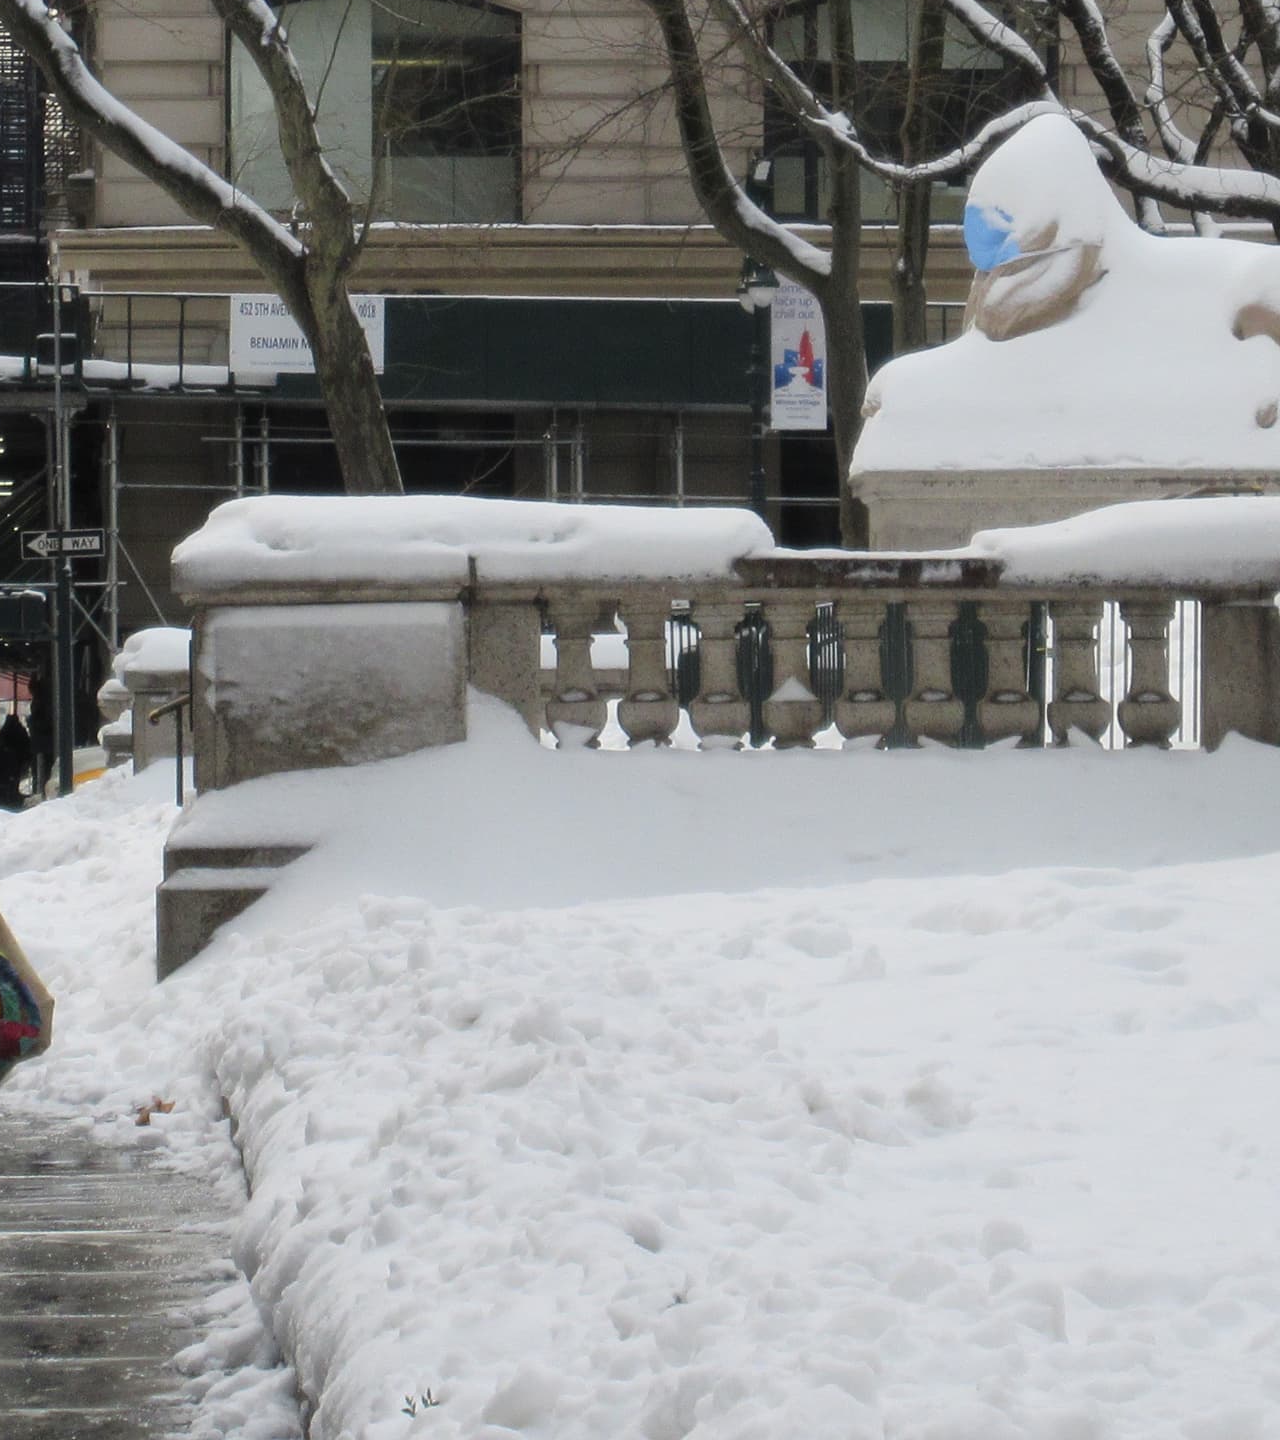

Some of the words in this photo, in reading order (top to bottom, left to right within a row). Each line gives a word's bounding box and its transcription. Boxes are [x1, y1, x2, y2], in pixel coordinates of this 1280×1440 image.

[239, 303, 253, 316] 452
[254, 303, 269, 317] 5TH
[356, 304, 376, 318] 0018
[799, 310, 815, 320] out
[250, 336, 299, 349] BENJAMIN
[71, 537, 95, 549] WAY
